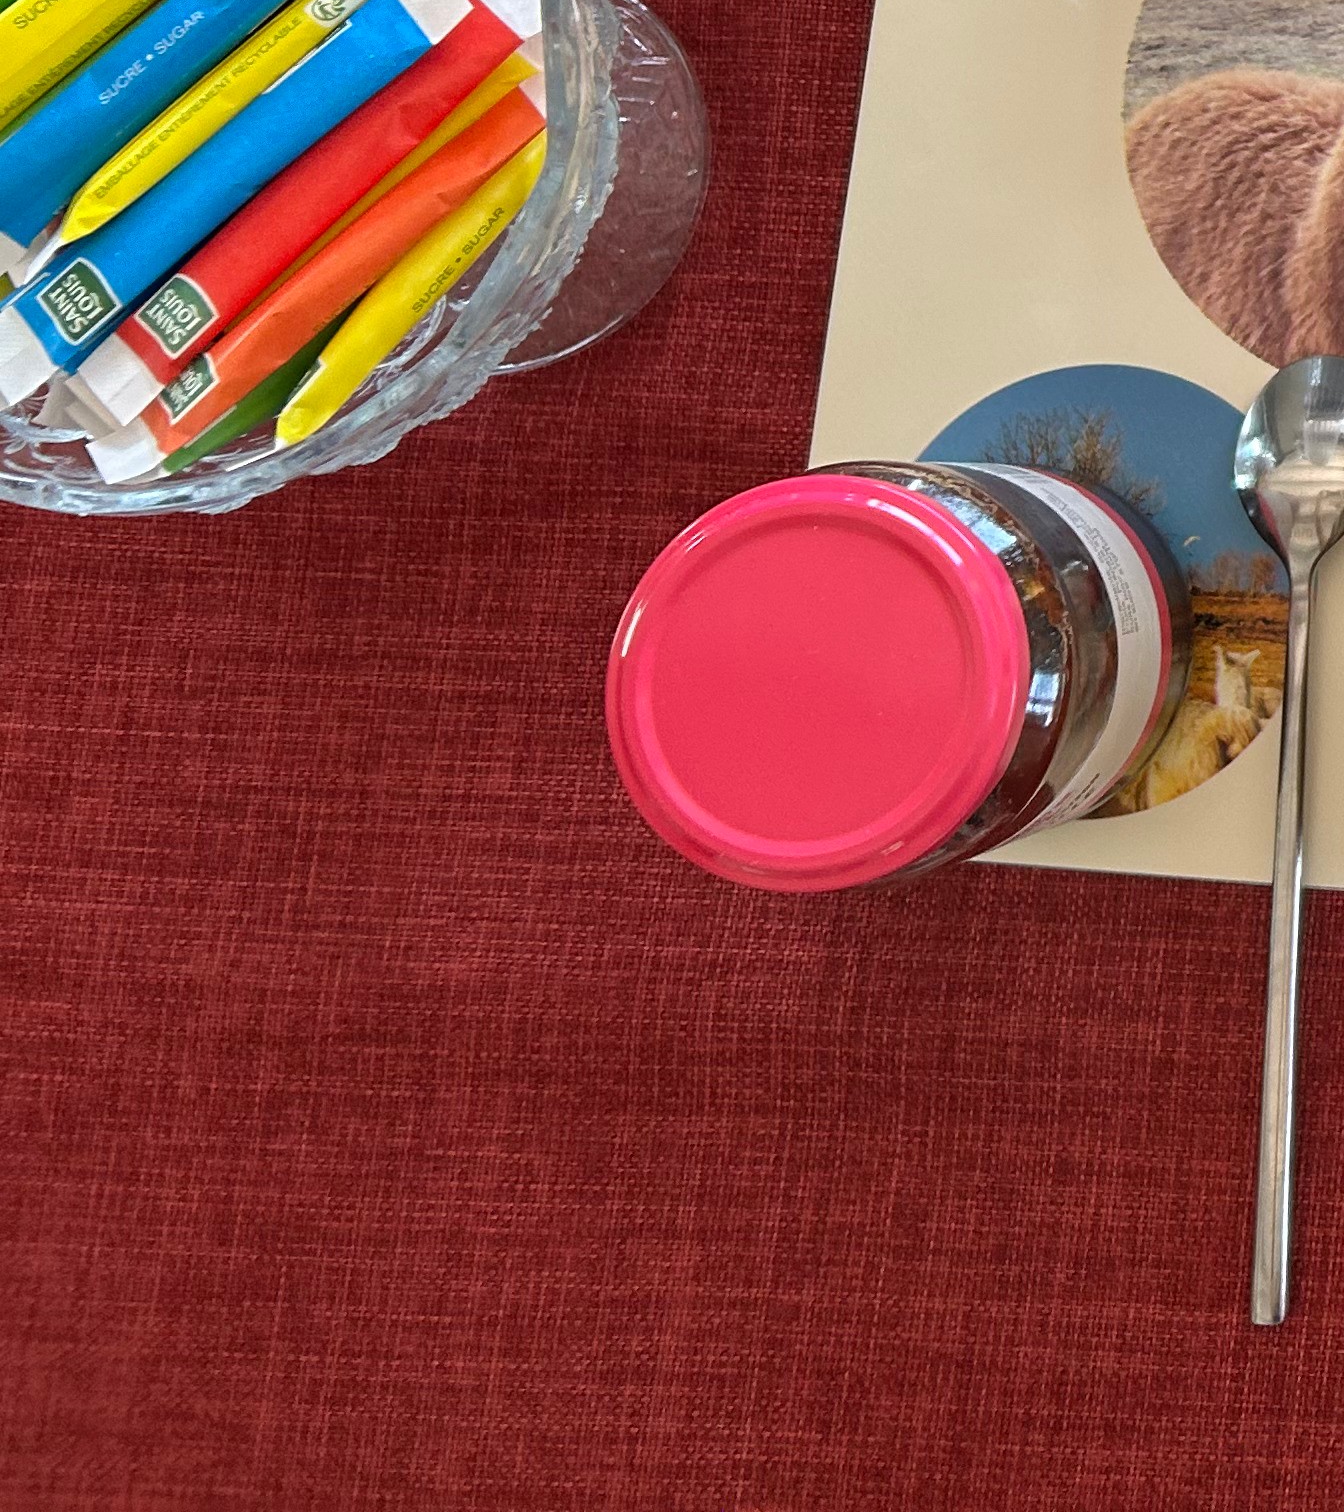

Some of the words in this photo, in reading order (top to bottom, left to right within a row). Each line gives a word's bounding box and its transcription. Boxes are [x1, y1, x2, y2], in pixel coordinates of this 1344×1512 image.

[98, 59, 146, 105] SUCRE
[154, 10, 205, 55] SUGAR
[412, 265, 455, 313] SUCRE
[462, 206, 505, 255] SUGAR
[49, 287, 89, 334] SAINT
[63, 273, 103, 320] LOUIS
[162, 288, 202, 331] LOUIS
[149, 303, 187, 345] SAINT
